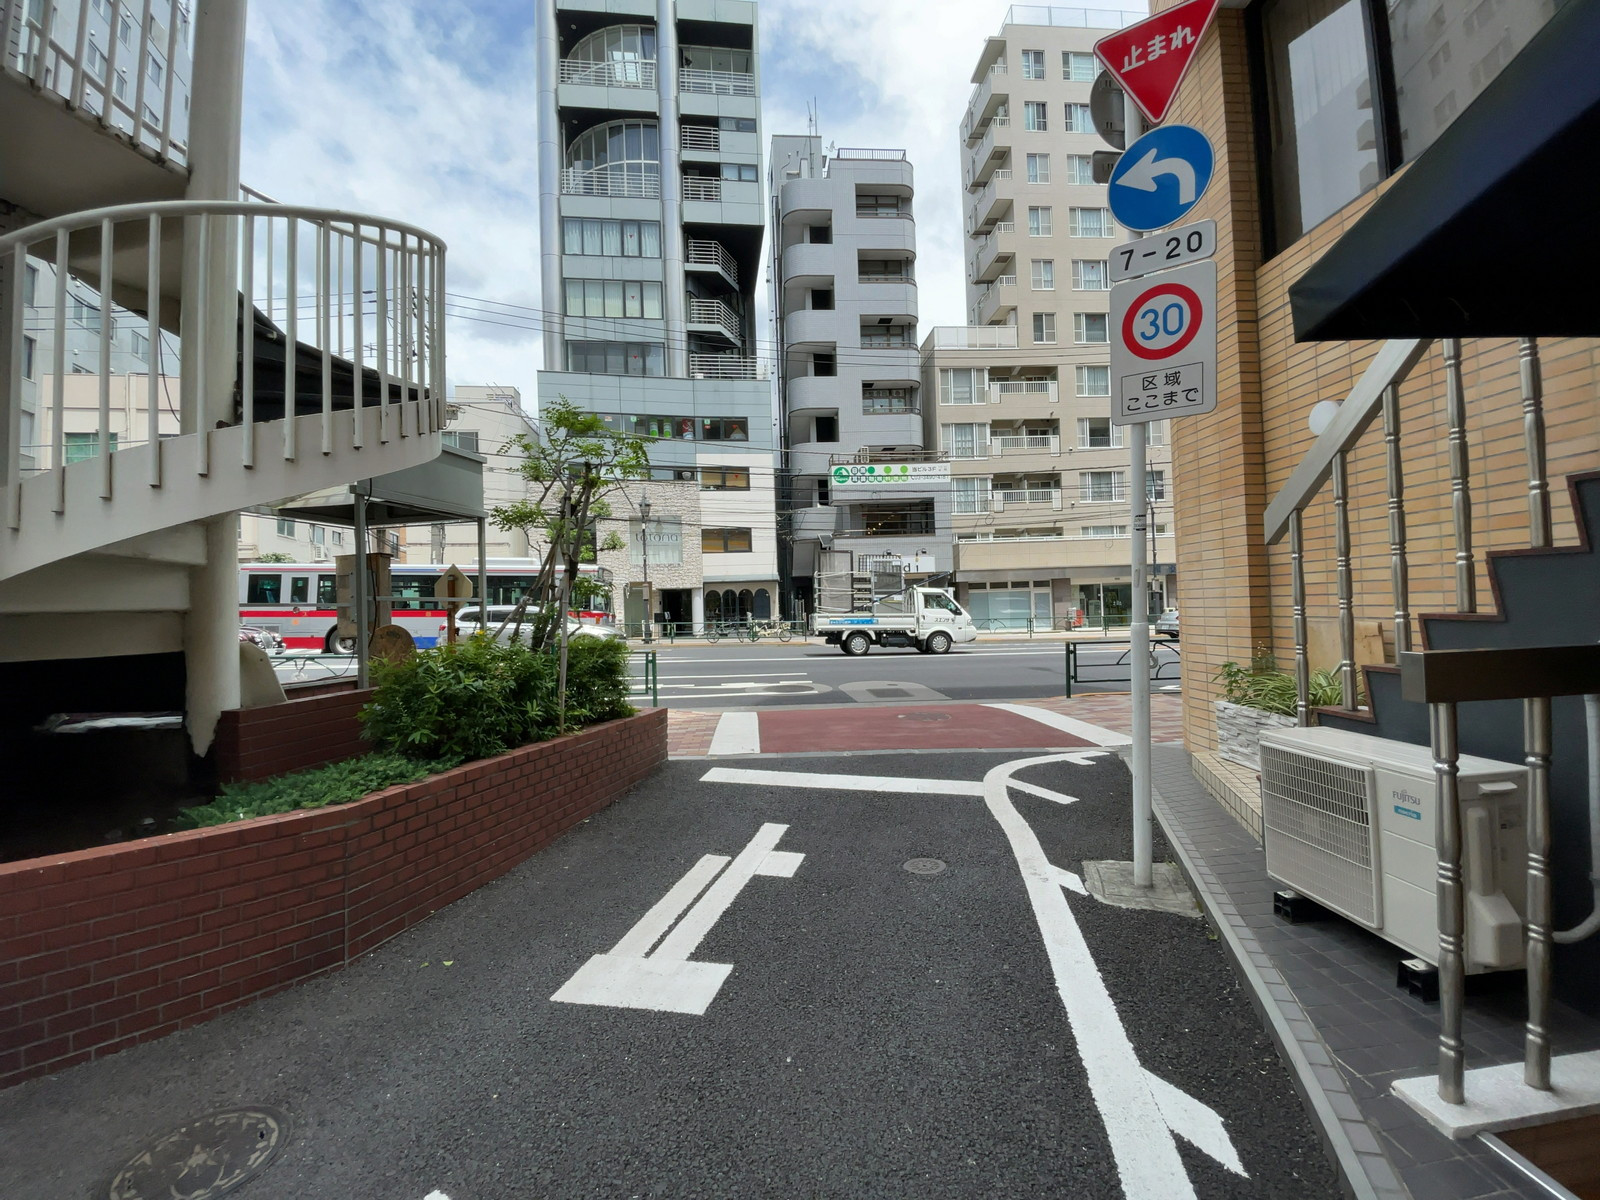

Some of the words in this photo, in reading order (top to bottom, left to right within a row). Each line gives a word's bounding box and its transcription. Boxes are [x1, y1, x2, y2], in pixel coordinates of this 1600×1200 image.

[1120, 24, 1196, 73] 止まれ
[1119, 230, 1203, 271] 7-20
[1139, 302, 1184, 341] 30
[1142, 370, 1182, 391] 区域
[1126, 387, 1200, 411] ここまで
[1392, 789, 1421, 805] FUJITSU
